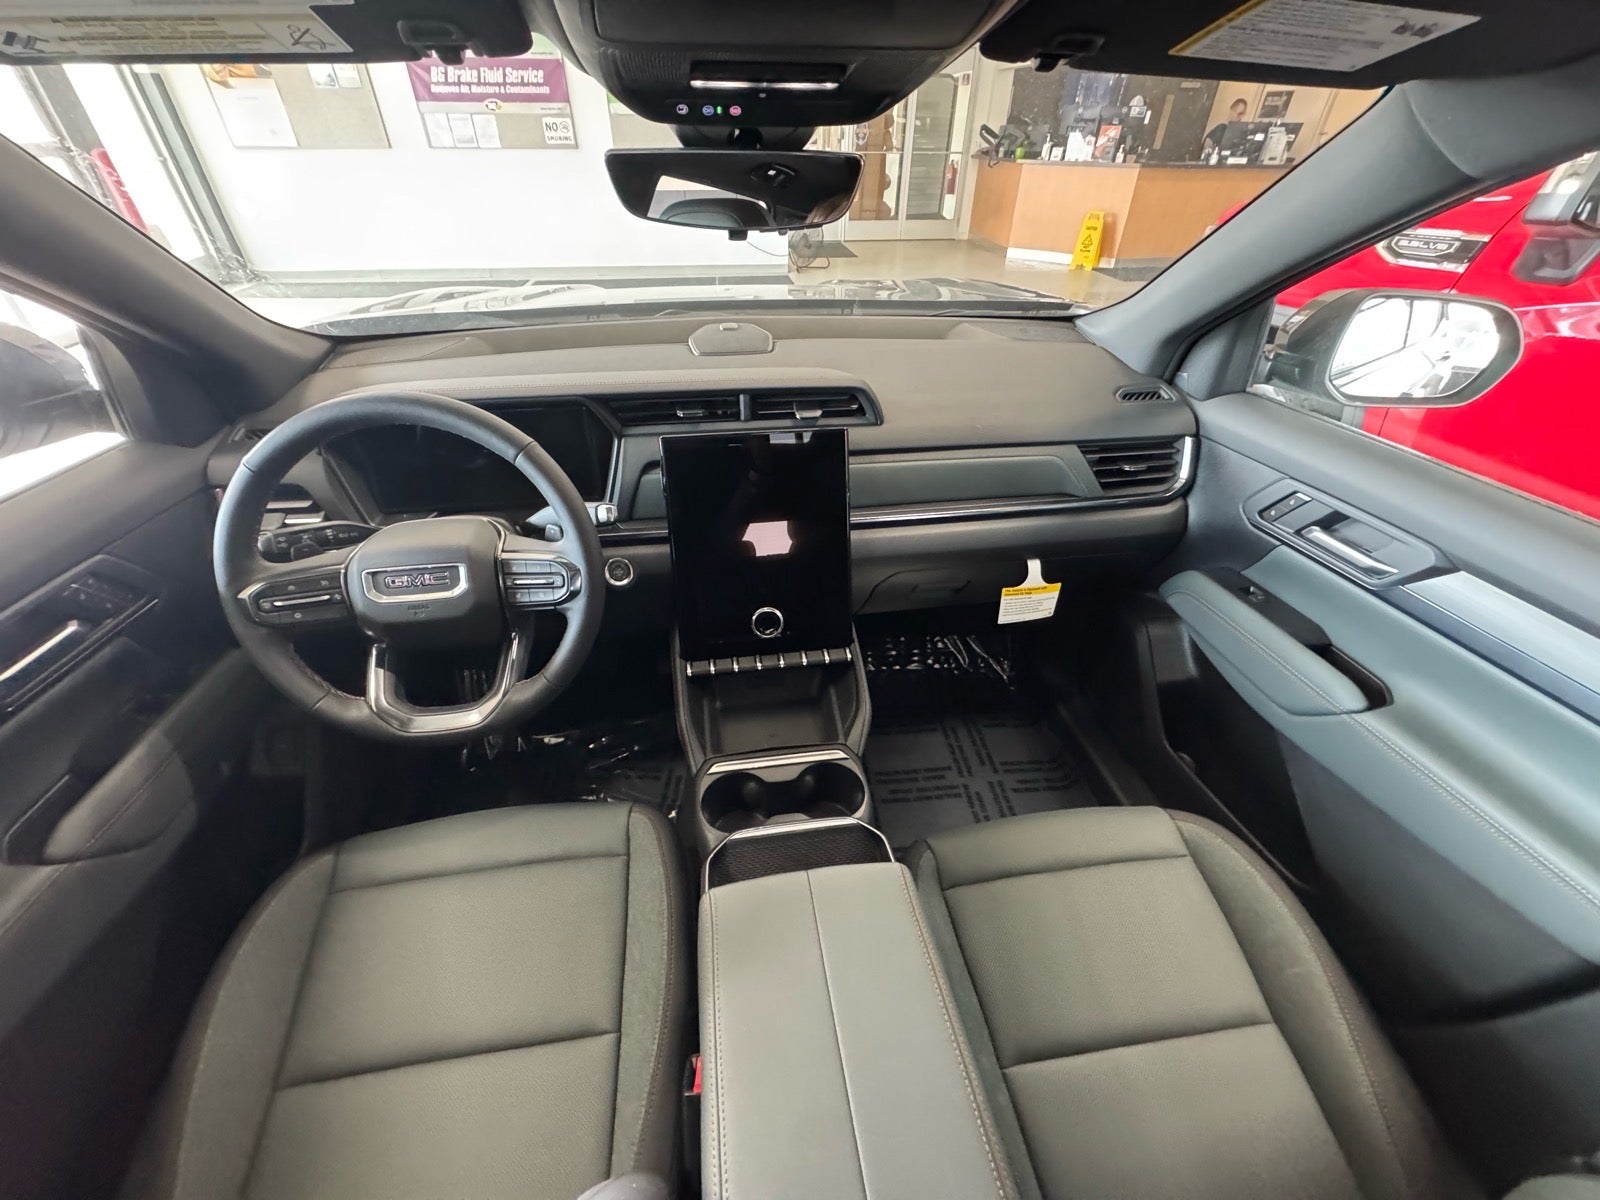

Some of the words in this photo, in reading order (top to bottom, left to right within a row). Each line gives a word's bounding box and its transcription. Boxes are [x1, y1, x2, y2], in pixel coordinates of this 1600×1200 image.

[430, 66, 445, 83] BG
[447, 66, 478, 83] Brake
[480, 66, 503, 83] Fluid
[505, 67, 544, 83] Service
[471, 85, 499, 93] Moisture
[506, 85, 550, 94] Contaminants
[545, 121, 559, 132] NO
[384, 571, 450, 589] GMC
